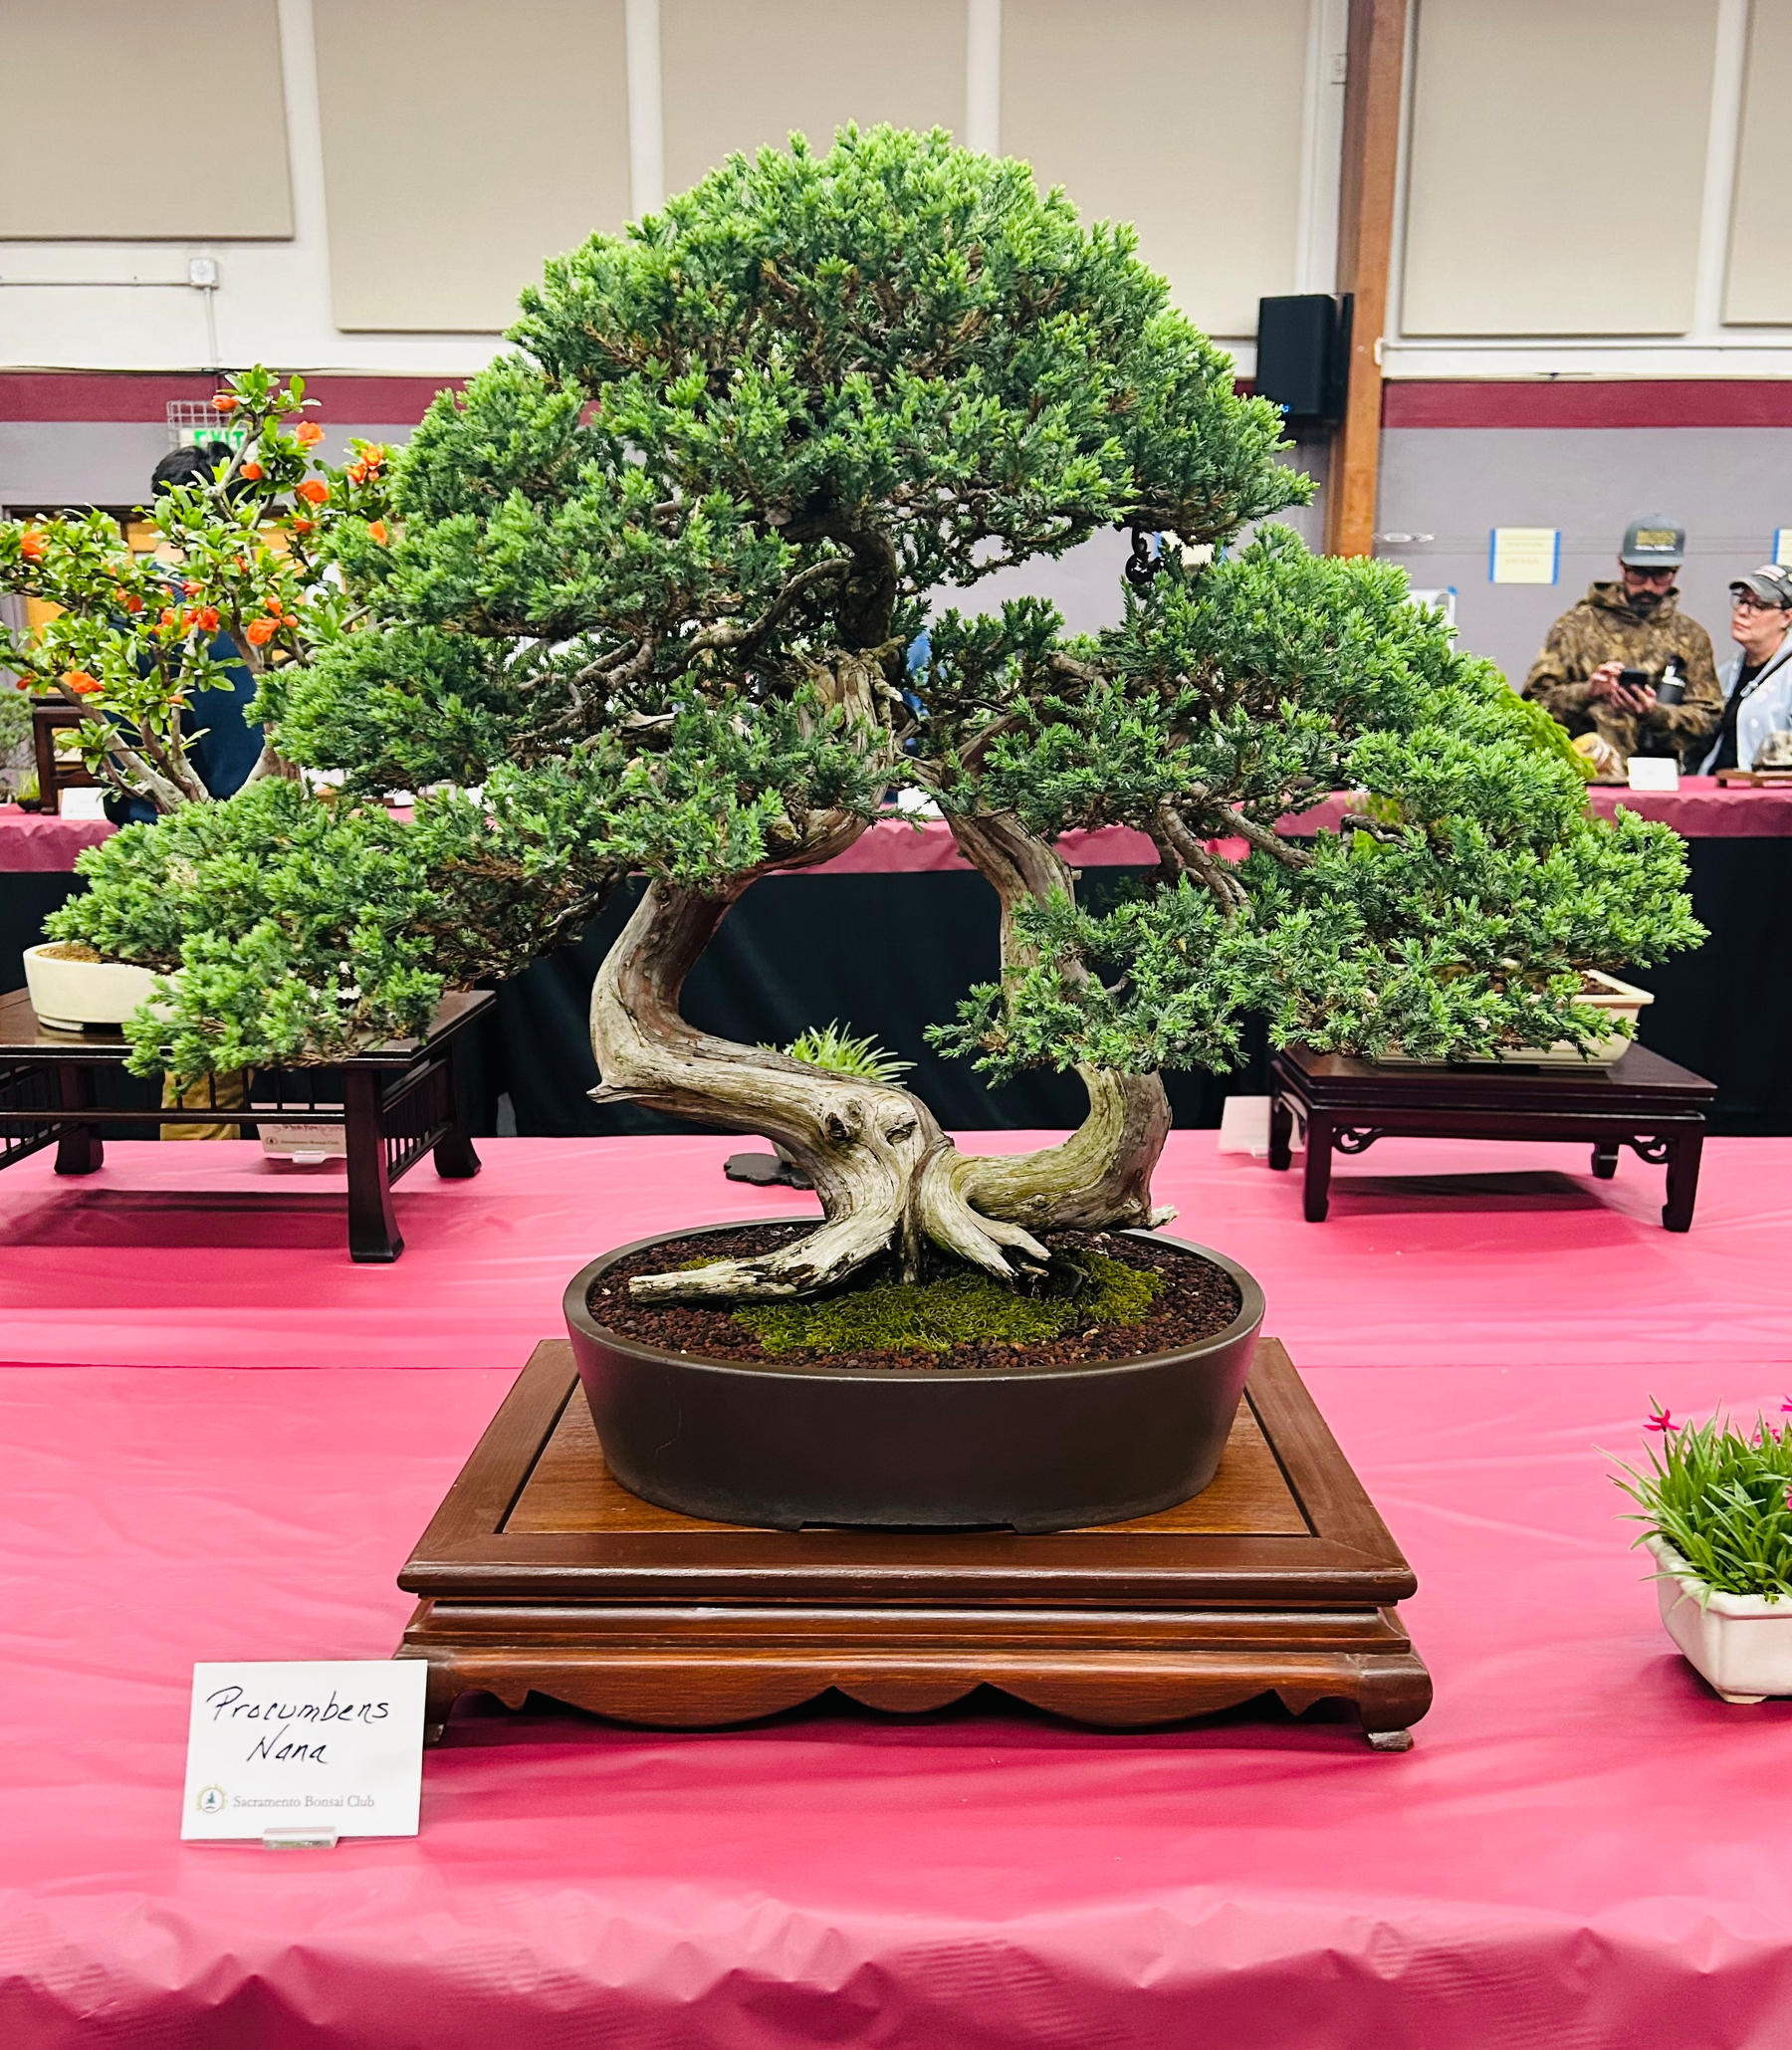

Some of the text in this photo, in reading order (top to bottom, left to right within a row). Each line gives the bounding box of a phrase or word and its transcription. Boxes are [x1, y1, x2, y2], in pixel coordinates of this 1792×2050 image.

[205, 1686, 389, 1723] Procumbens
[246, 1723, 330, 1764] Nana
[233, 1795, 375, 1808] Sacramento Bonsai Club
